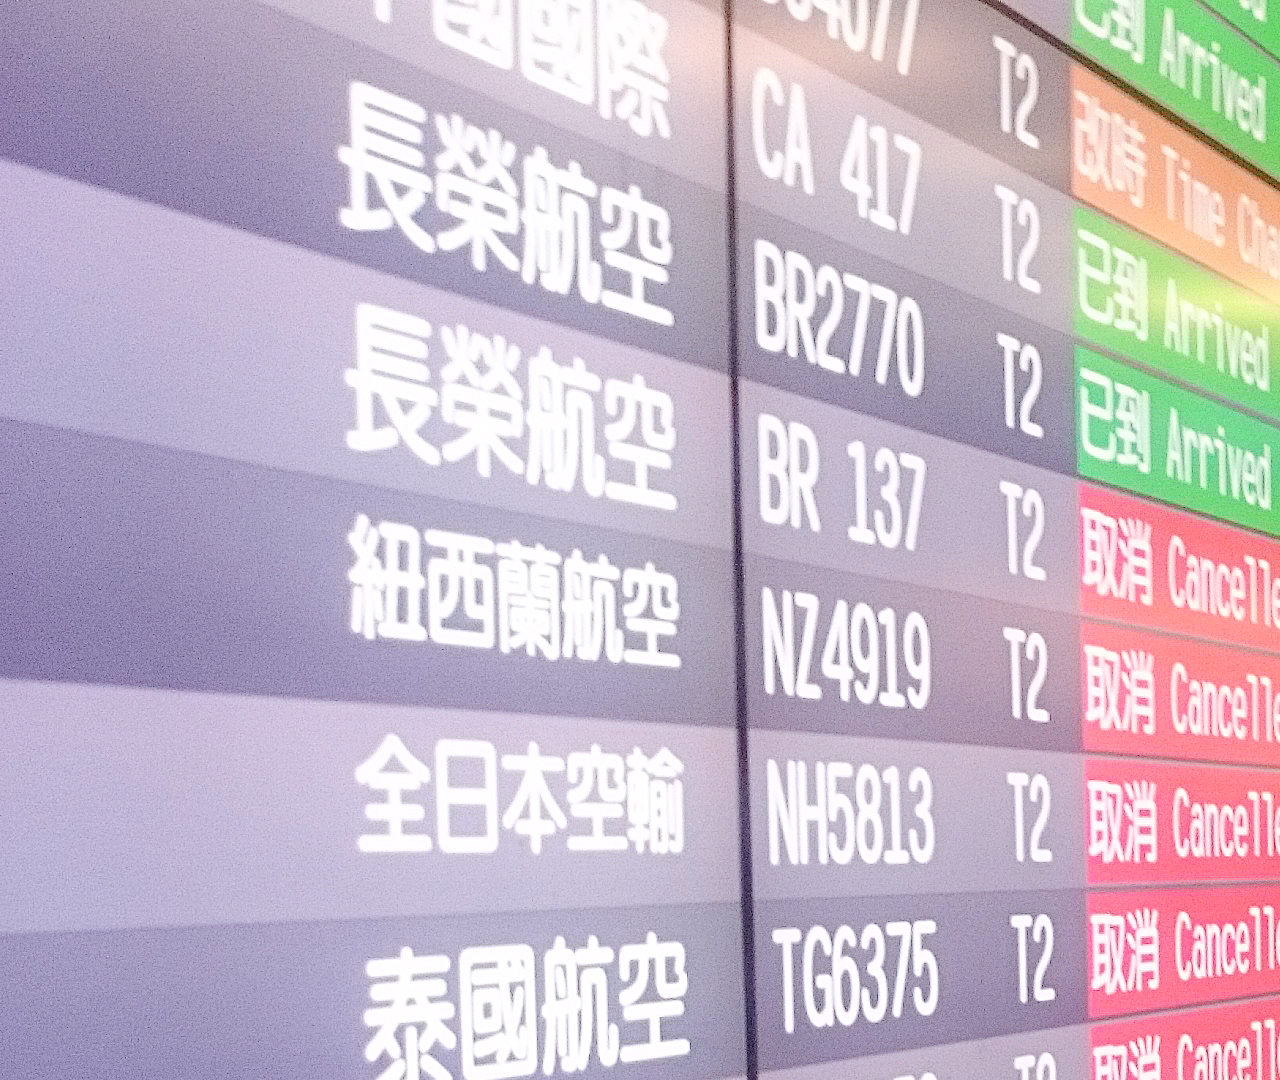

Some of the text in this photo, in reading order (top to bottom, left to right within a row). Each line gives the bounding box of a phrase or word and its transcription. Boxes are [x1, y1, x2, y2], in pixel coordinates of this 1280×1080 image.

[993, 36, 1040, 149] T2
[1072, 90, 1147, 208] 改時
[1161, 144, 1226, 249] Time
[1158, 9, 1267, 143] Arrived
[338, 81, 674, 327] 長榮航空
[755, 238, 925, 398] BR2770
[997, 334, 1044, 438] T2
[1079, 366, 1150, 473] 已到
[1165, 405, 1272, 512] Arrived
[374, 0, 1270, 393] 國國際 CA 417 T2 已到 Arrived
[345, 303, 677, 510] 長榮航空
[757, 413, 820, 532] BR
[845, 440, 927, 551] 137
[1000, 481, 1047, 582] T2
[1080, 507, 1153, 606] 取消
[347, 513, 681, 668] 紐西蘭航空
[761, 587, 930, 710] NZ4919
[1003, 627, 1050, 722] T2
[1084, 644, 1155, 736] 取消
[355, 733, 684, 855] 全日本空輸
[766, 758, 935, 865] NH5813
[1007, 773, 1053, 863] T2
[1087, 779, 1157, 863] 取消
[772, 920, 939, 1033] TG6375
[1011, 914, 1056, 1004] T2
[1090, 907, 1160, 995] 取消
